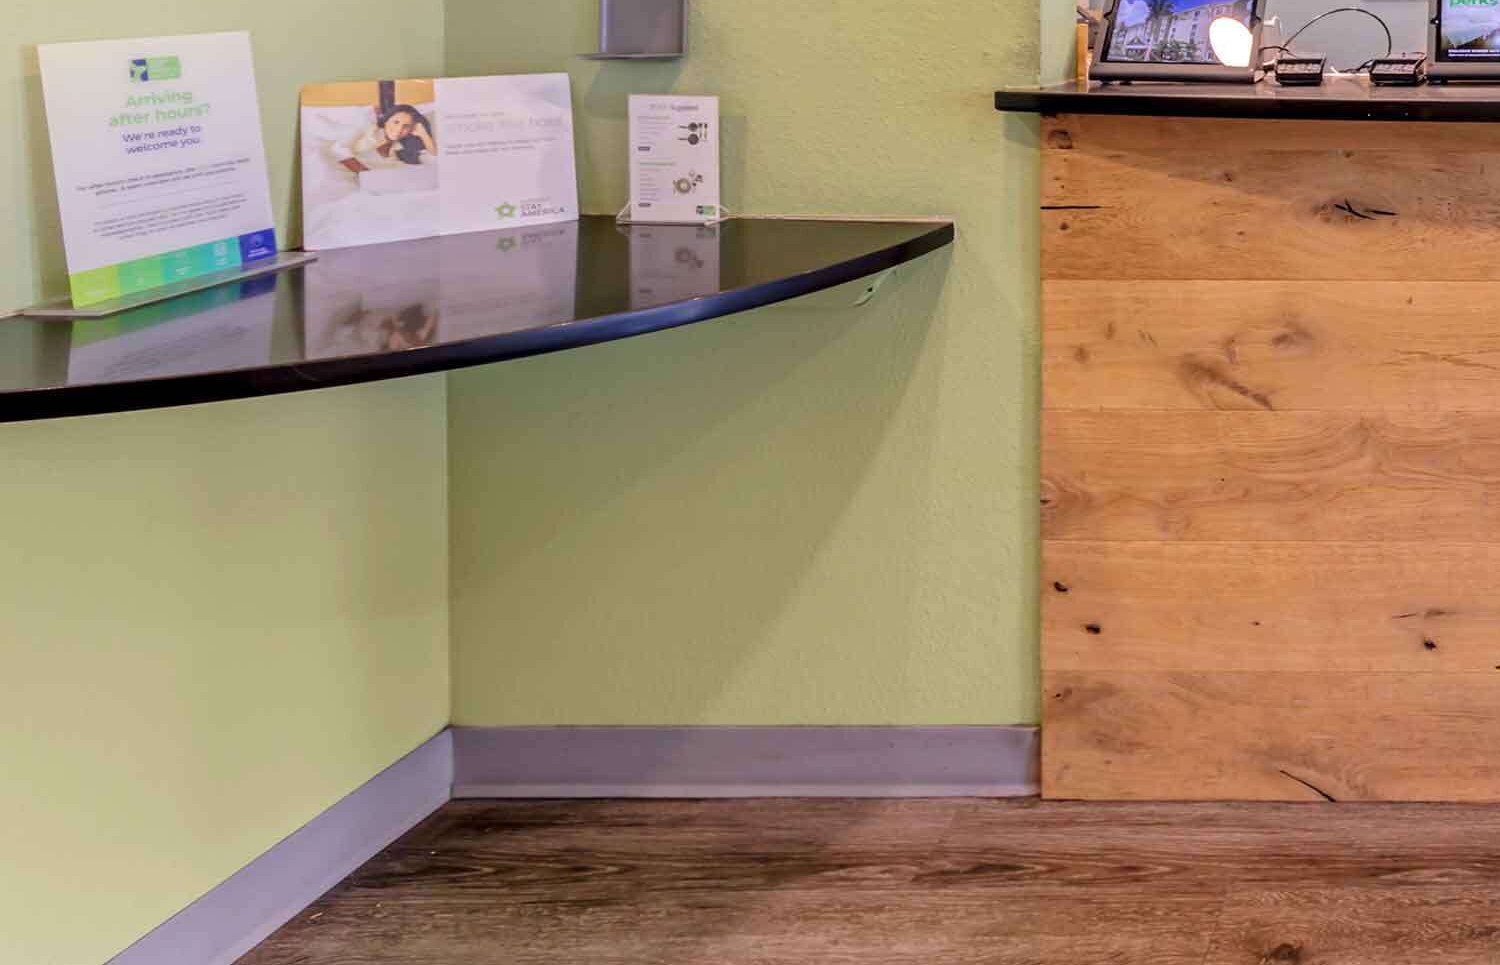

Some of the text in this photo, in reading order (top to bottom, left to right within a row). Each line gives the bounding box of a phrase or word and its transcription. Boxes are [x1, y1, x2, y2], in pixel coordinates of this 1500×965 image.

[126, 90, 193, 107] Arriving
[109, 111, 150, 127] after
[158, 126, 187, 139] ready
[190, 125, 202, 134] to
[126, 139, 178, 155] welcome
